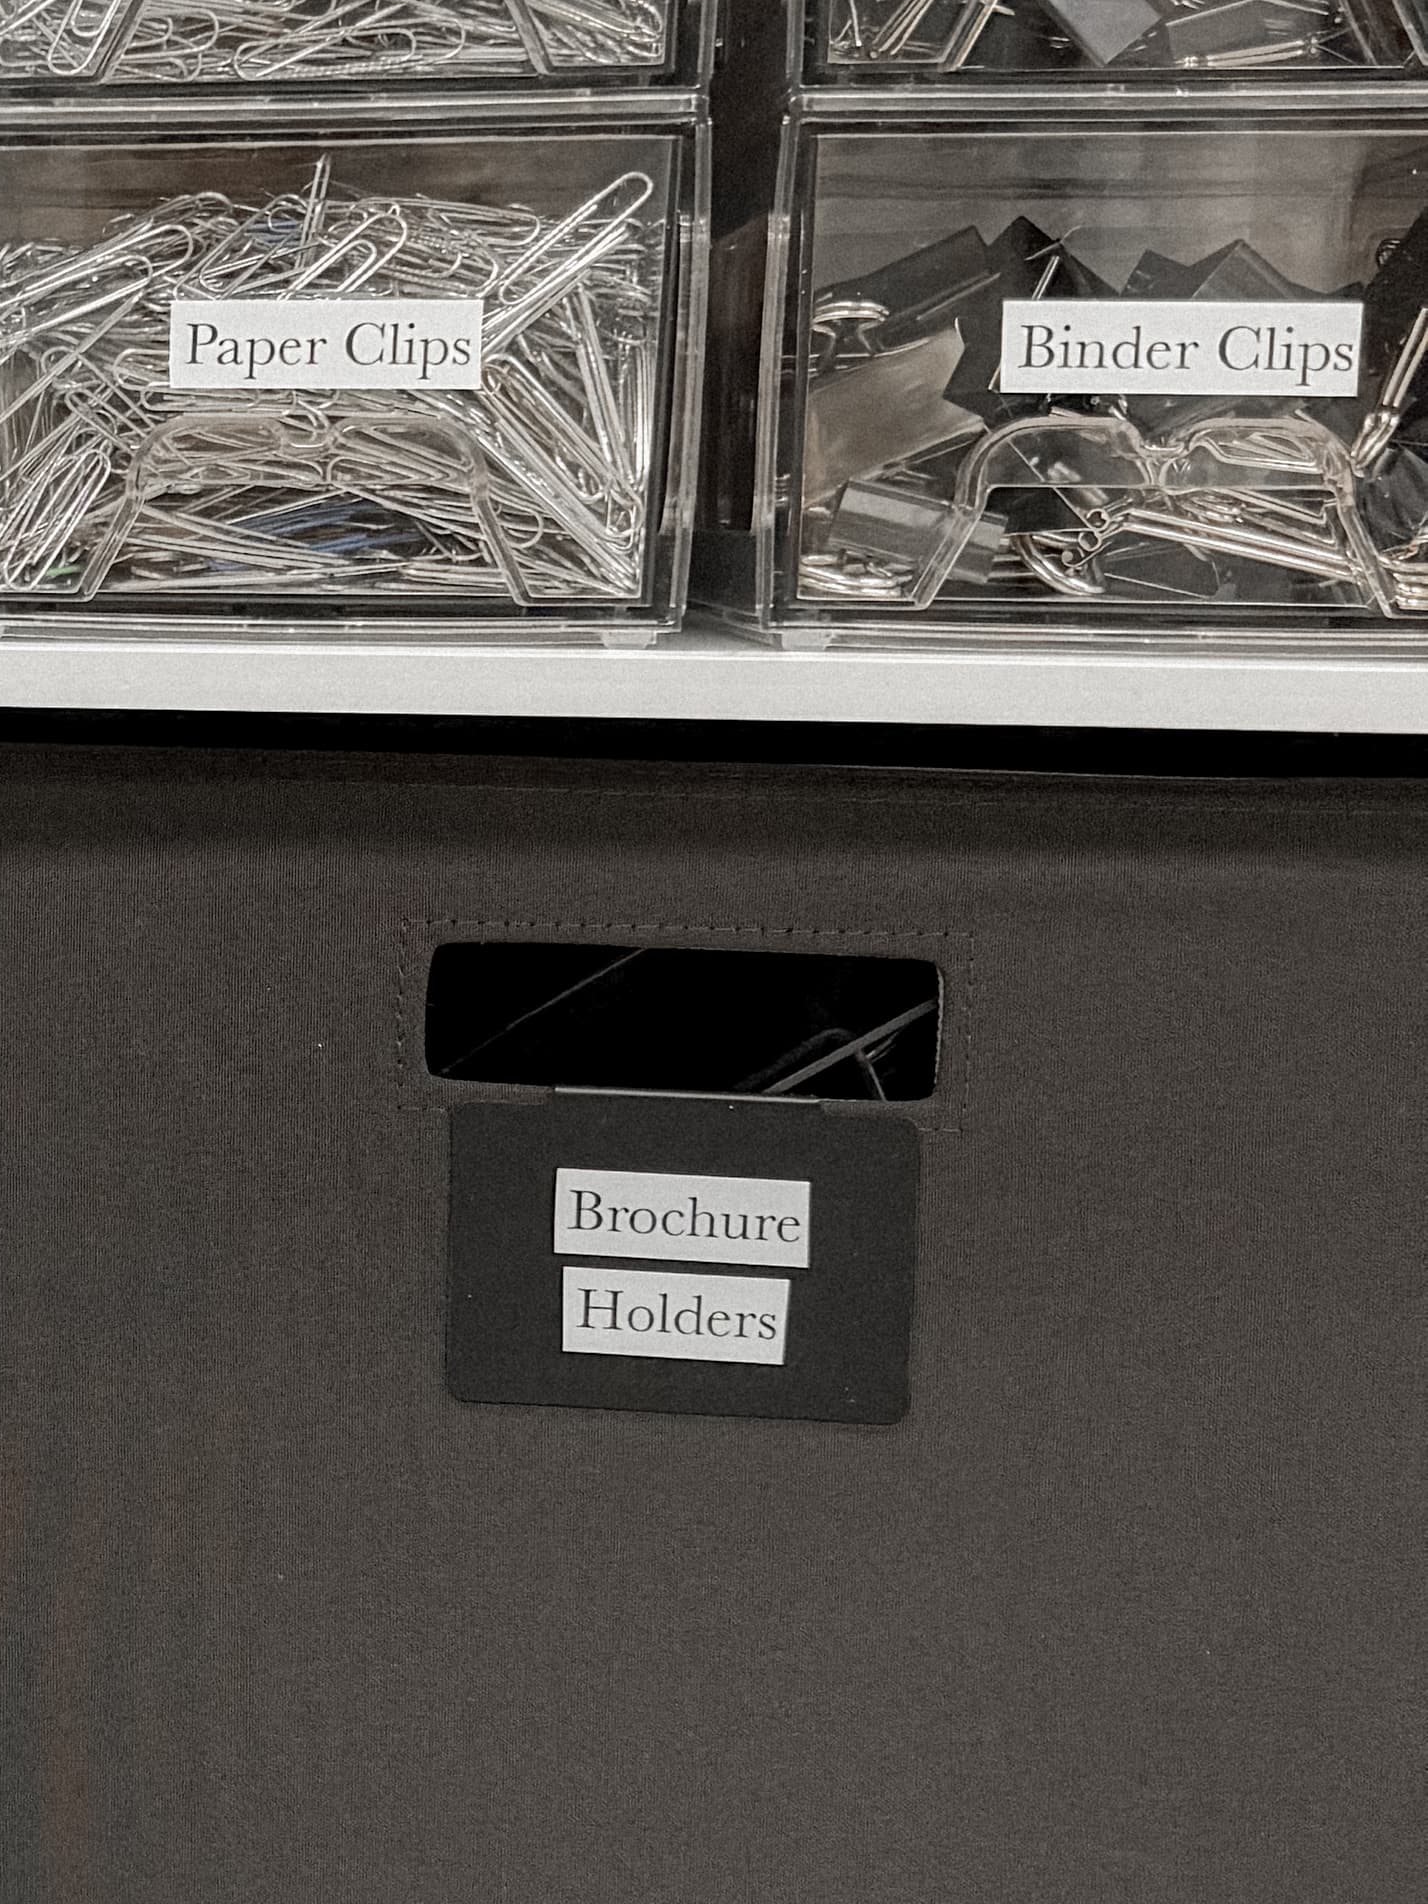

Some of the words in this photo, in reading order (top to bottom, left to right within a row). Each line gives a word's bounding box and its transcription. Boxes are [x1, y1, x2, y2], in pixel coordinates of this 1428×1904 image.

[185, 321, 328, 381] Paper
[345, 321, 473, 379] Clips
[1017, 323, 1200, 371] Binder
[1218, 324, 1356, 389] Clips
[567, 1189, 801, 1243] Brochure
[576, 1287, 778, 1341] Holders
